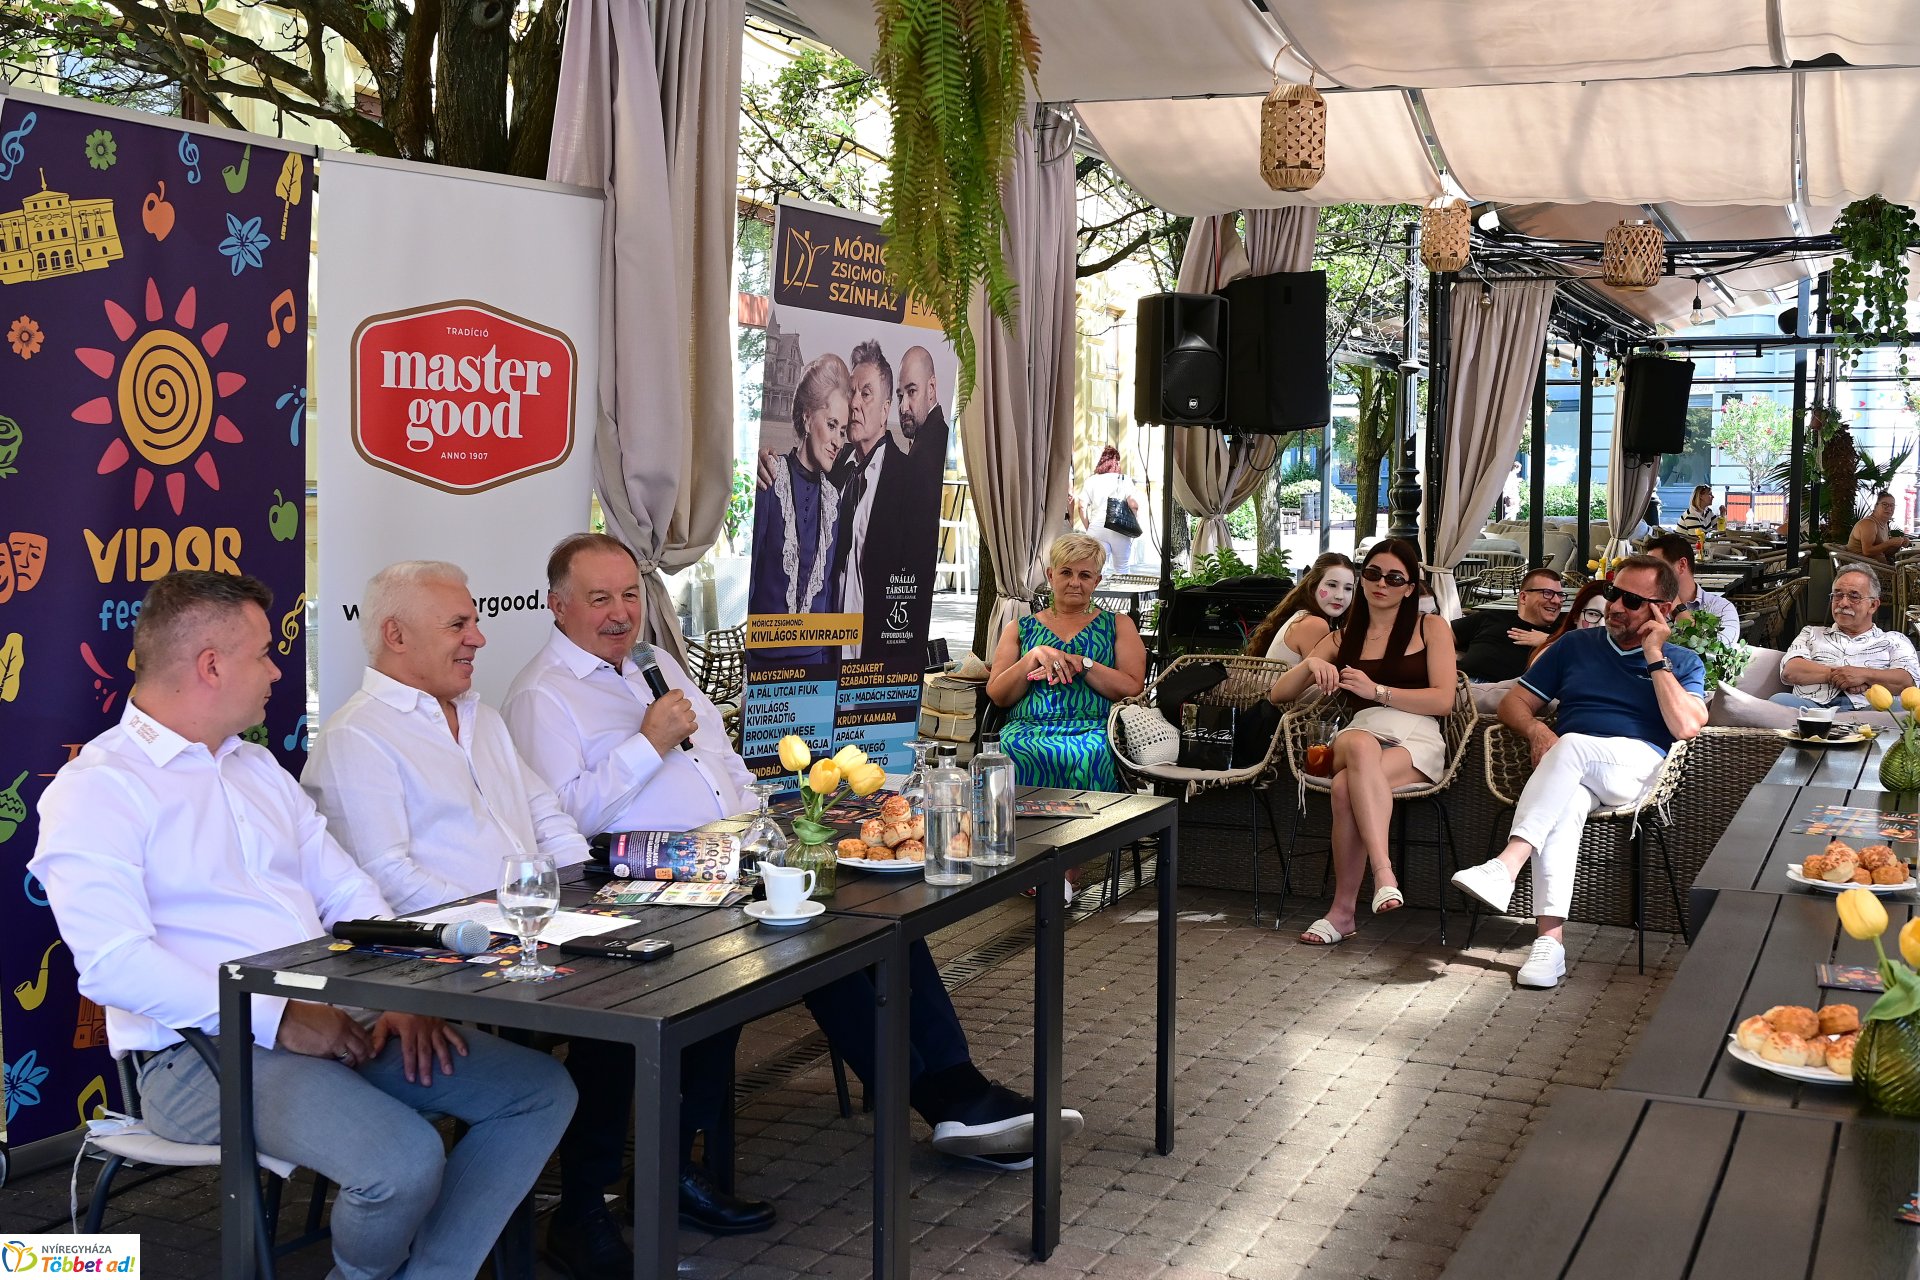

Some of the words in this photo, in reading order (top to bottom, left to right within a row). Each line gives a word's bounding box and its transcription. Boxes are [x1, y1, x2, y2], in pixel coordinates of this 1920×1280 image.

[834, 236, 889, 266] MÓRIC
[829, 281, 898, 311] SZÍNHÁZ
[911, 299, 939, 318] ÉVA
[446, 326, 489, 338] TRADÍCIÓ
[380, 344, 552, 396] master
[406, 391, 523, 452] good
[440, 451, 467, 461] ANNO
[469, 452, 488, 460] 1907
[83, 526, 243, 584] VIDOR
[889, 573, 916, 584] ÖNÁLLÓ
[885, 584, 918, 594] TÁRSULAT
[751, 619, 773, 627] MÓRICZ
[774, 618, 804, 627] ZSIGMOND:
[750, 628, 798, 642] KIVILÁGOS
[799, 629, 859, 641] KIVIRRADTIG
[750, 668, 806, 682] NAGYSZÍNPAD
[841, 662, 884, 674] RÓZSAKERT
[840, 673, 885, 686] SZABADTÉRI
[886, 672, 919, 684] SZÍNPAD
[748, 690, 755, 699] A
[756, 685, 771, 699] PÁL
[773, 685, 796, 697] UTCAI
[798, 683, 819, 695] FIÚK
[839, 693, 851, 703] SIX
[855, 688, 885, 701] MADÁCH
[886, 687, 918, 699] SZÍNHÁZ
[747, 700, 789, 715] KIVILÁGOS
[746, 712, 796, 726] KIVIRRADTIG
[837, 712, 862, 726] KRÚDY
[863, 712, 897, 723] KAMARA
[745, 728, 790, 741] BROOKLYNI
[791, 725, 815, 736] MESE
[835, 728, 865, 742] APÁCÁK
[744, 745, 755, 756] LA
[756, 742, 779, 755] MANC
[805, 738, 829, 750] AGJA
